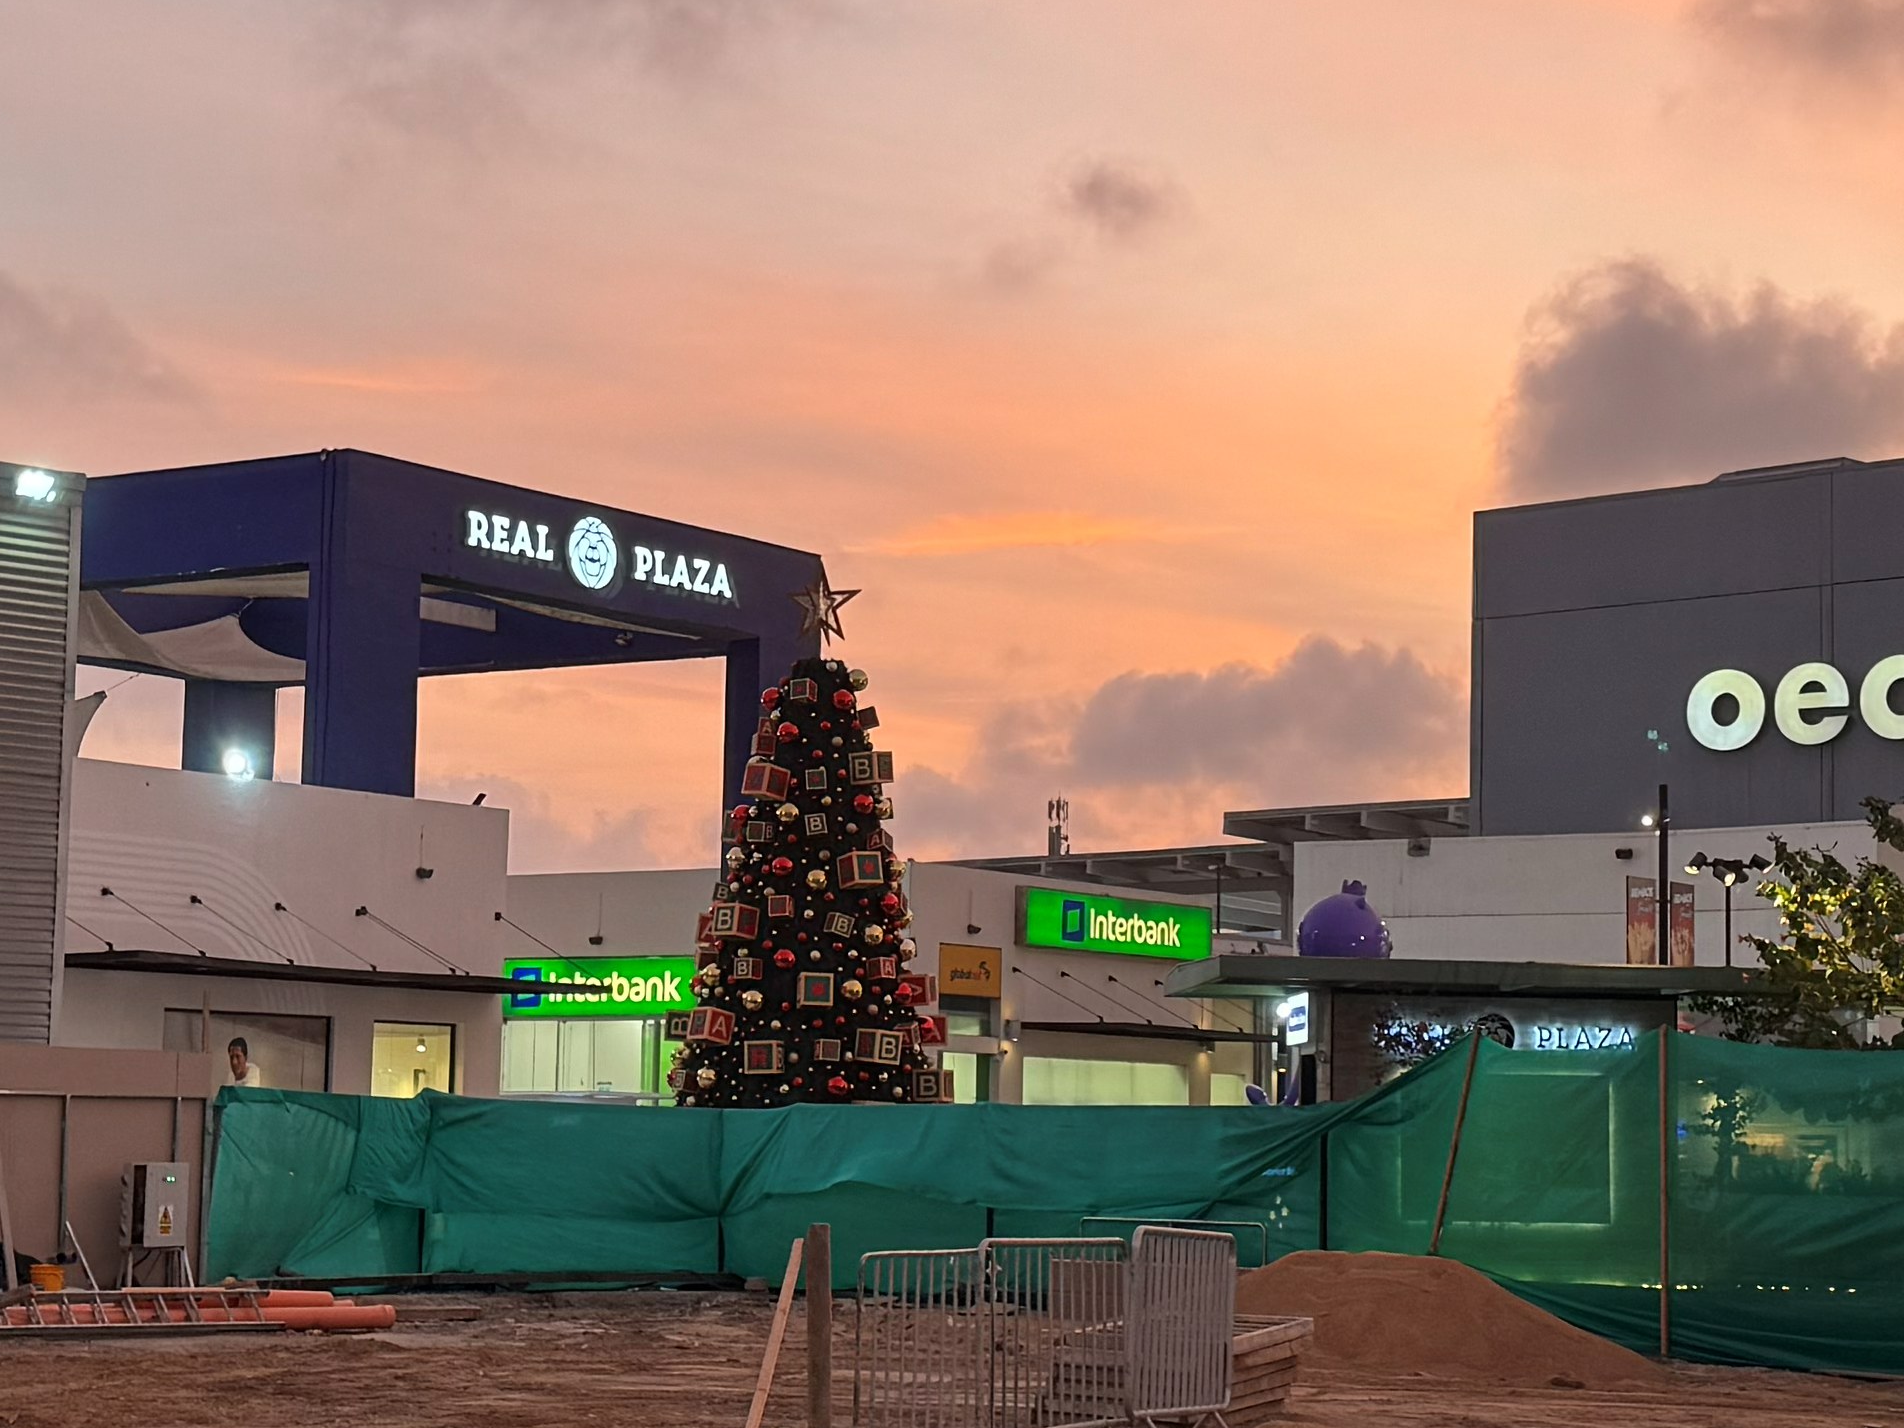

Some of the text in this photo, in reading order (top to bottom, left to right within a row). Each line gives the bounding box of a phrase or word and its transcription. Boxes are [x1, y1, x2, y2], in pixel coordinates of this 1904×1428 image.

[466, 510, 733, 599] REAL PLAZA
[1089, 907, 1181, 948] Interbank
[1536, 1025, 1634, 1051] PLAZA
